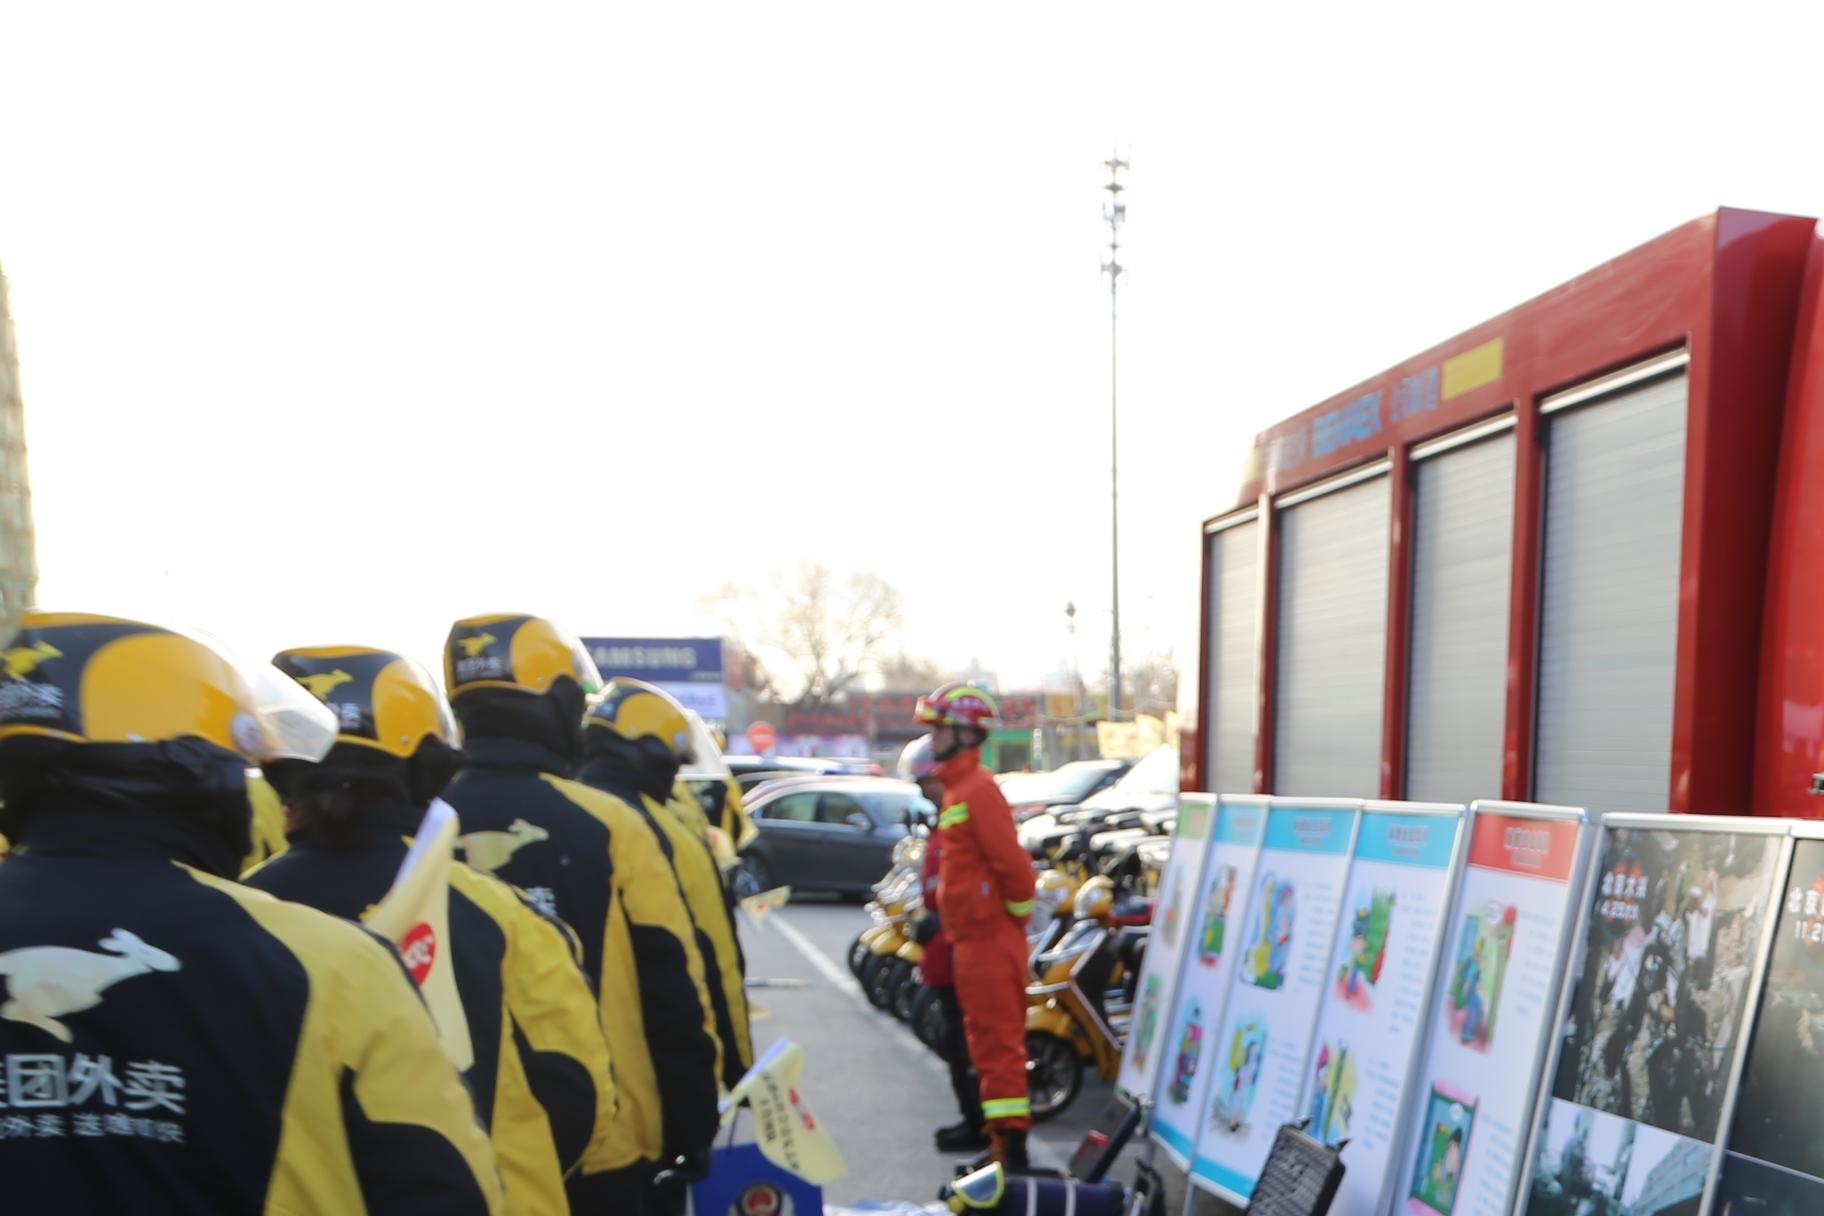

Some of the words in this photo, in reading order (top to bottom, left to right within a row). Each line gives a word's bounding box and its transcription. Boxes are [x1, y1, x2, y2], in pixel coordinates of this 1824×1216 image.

[592, 646, 697, 668] AMSUNG
[0, 1053, 186, 1115] 团外卖
